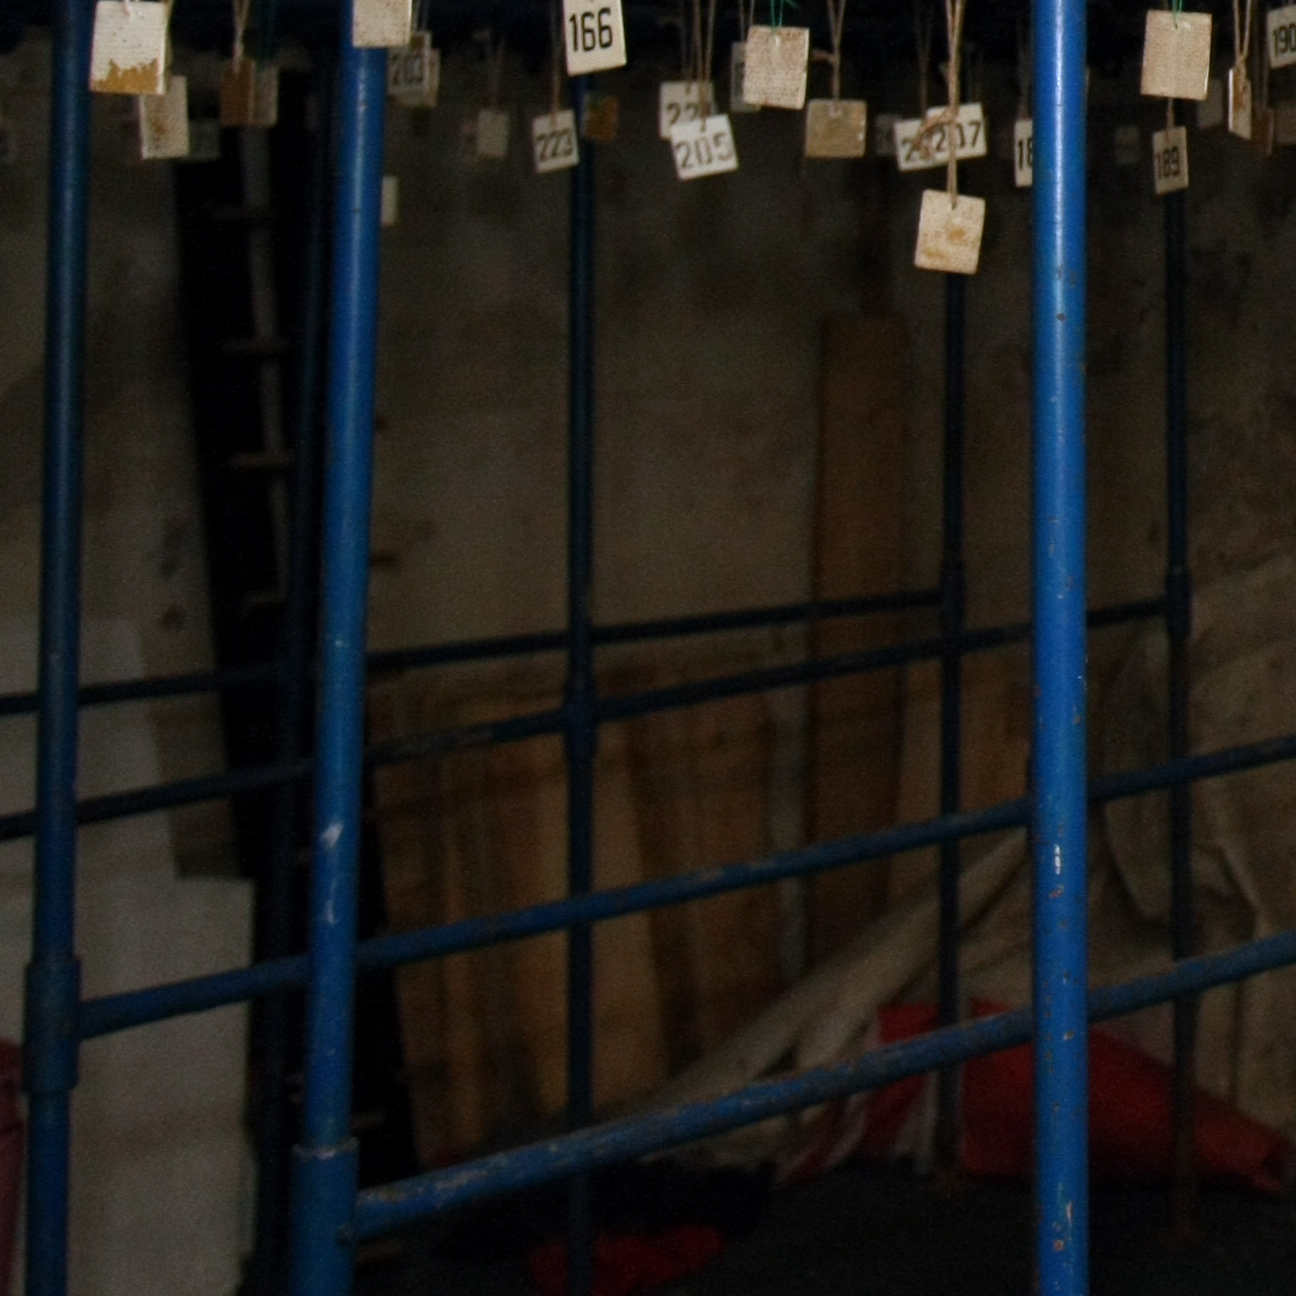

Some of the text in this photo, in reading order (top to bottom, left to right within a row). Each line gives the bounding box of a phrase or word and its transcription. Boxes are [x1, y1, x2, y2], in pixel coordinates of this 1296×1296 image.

[568, 7, 614, 53] 166
[536, 126, 573, 164] 223
[675, 132, 735, 169] 205
[1156, 146, 1181, 179] 189
